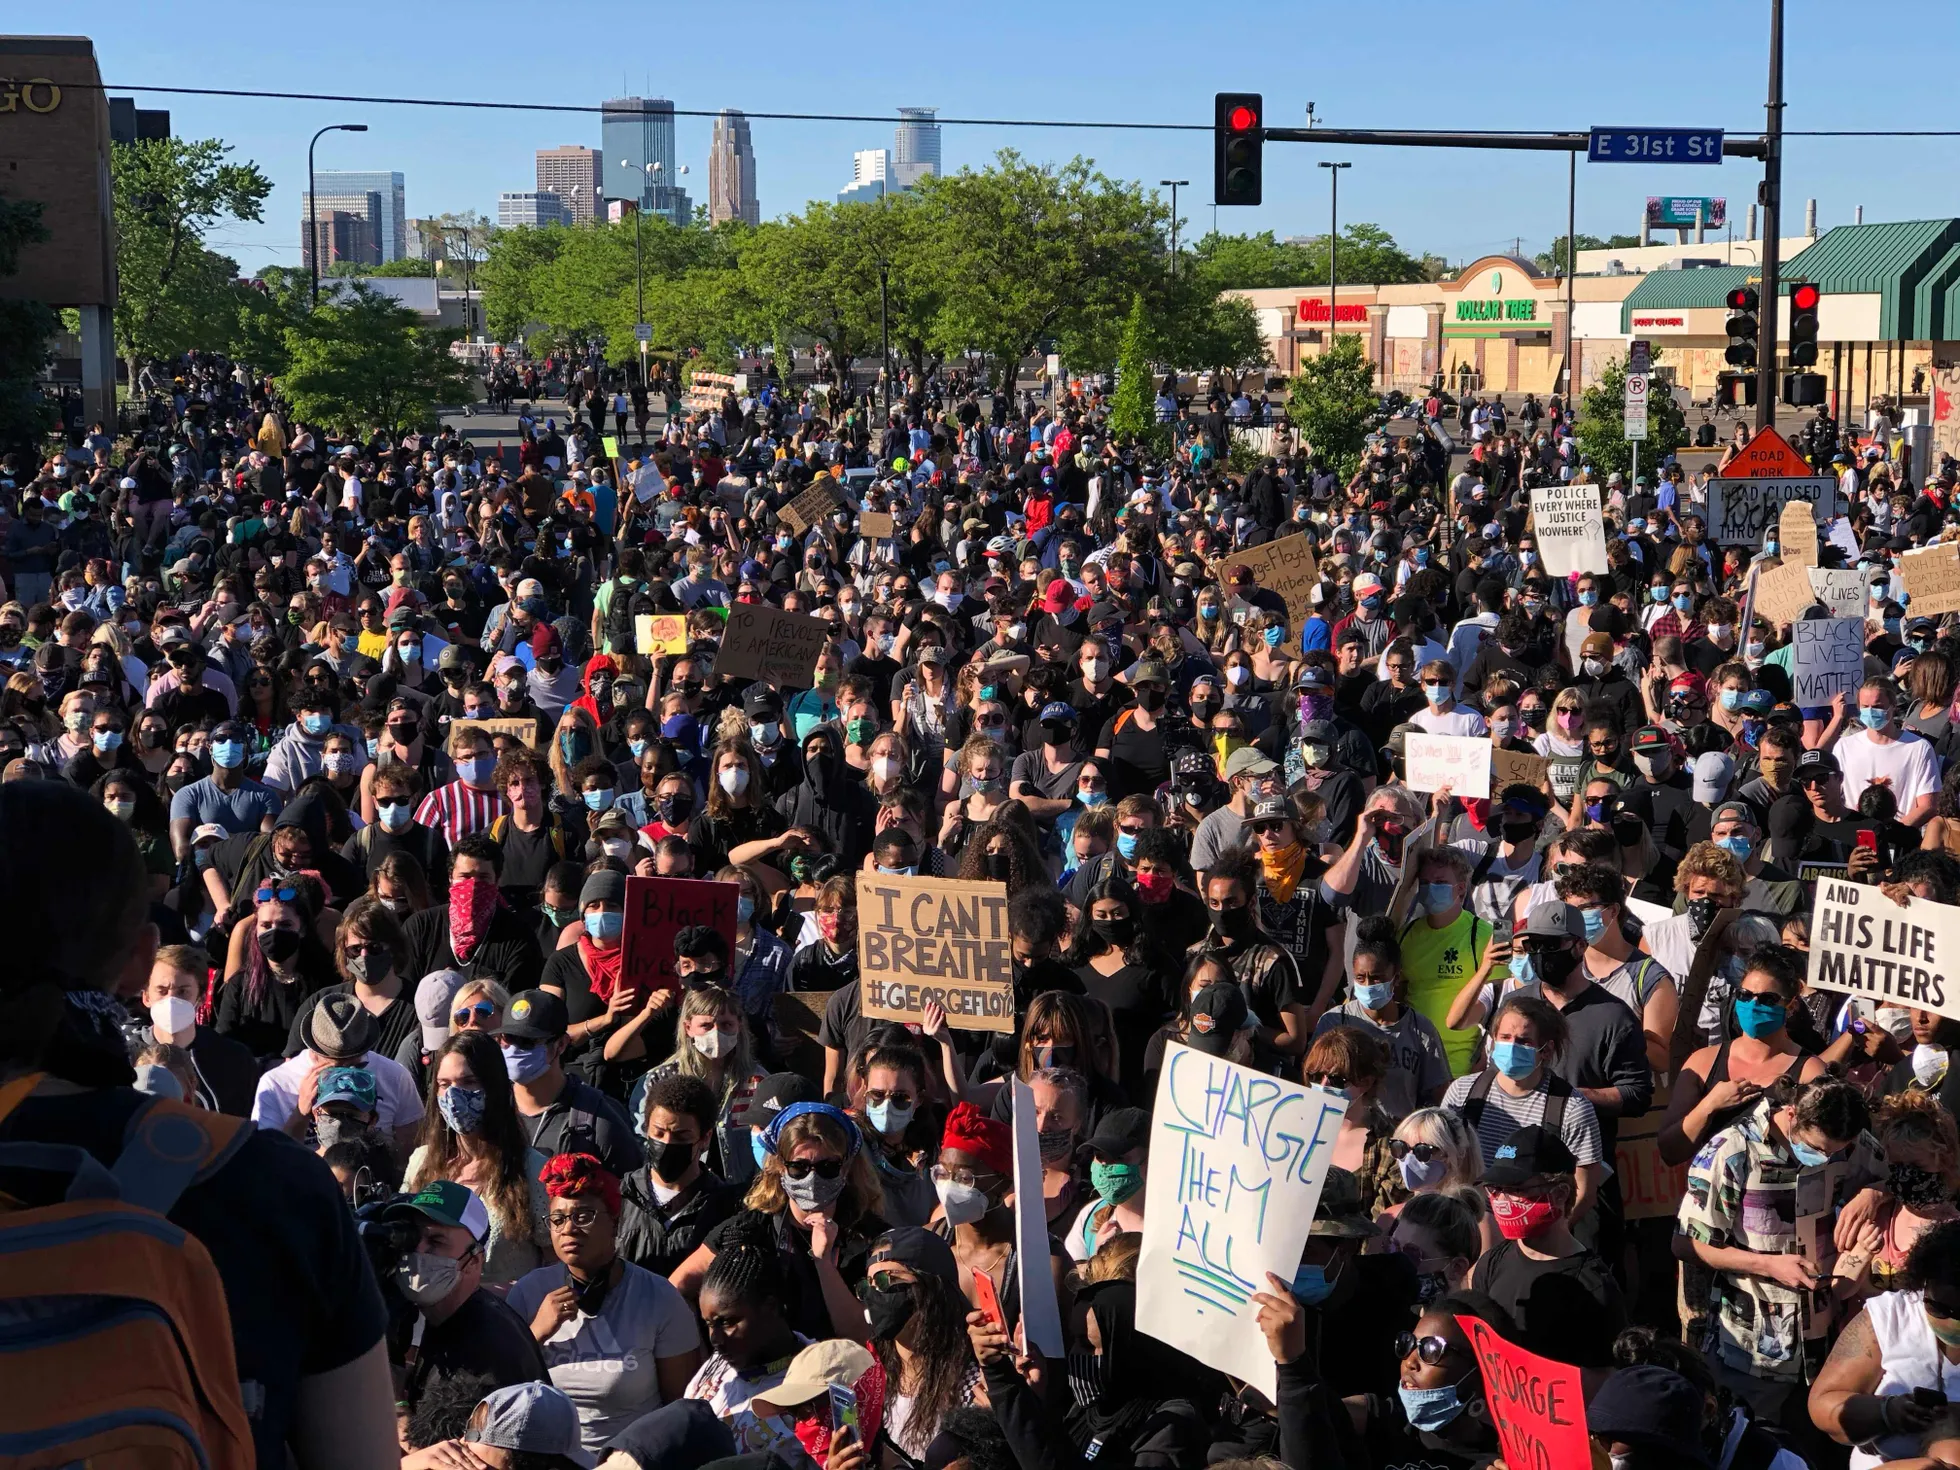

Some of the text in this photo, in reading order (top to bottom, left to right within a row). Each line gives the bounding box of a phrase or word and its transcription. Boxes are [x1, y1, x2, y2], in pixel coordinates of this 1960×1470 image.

[1597, 134, 1714, 156] E 31st St
[1456, 299, 1534, 319] DOLLAR TREE
[1750, 450, 1784, 462] ROAD
[1750, 468, 1784, 477] WORK
[1547, 488, 1588, 499] POLICE
[1549, 512, 1586, 523] JUSTICE
[1538, 526, 1584, 537] NOWHERE
[1266, 541, 1307, 570] Floyd
[1904, 555, 1954, 572] WHITE
[1908, 572, 1940, 584] COATS
[1831, 586, 1860, 601] LIVES
[1909, 584, 1944, 598] BLACK
[1285, 594, 1309, 611] aylor
[1796, 620, 1861, 644] BLACK
[748, 638, 815, 662] AMERICAN
[1796, 643, 1860, 664] LIVES
[1796, 670, 1863, 703] MATTER
[1410, 738, 1424, 758] So
[1446, 743, 1462, 758] YOU
[1550, 766, 1578, 776] BLAC
[1826, 884, 1860, 906] AND
[642, 888, 729, 928] Black
[910, 892, 1006, 940] CANT
[1820, 908, 1935, 964] HIS LIFE
[628, 932, 671, 977] live
[864, 931, 1012, 984] BREATHE
[1438, 964, 1463, 974] EMS
[1818, 950, 1945, 1008] MATTERS
[1170, 1050, 1344, 1184] CHARGE
[1163, 1122, 1272, 1245] THEM
[1176, 1204, 1257, 1290] ALL
[1474, 1322, 1574, 1426] GEORGE
